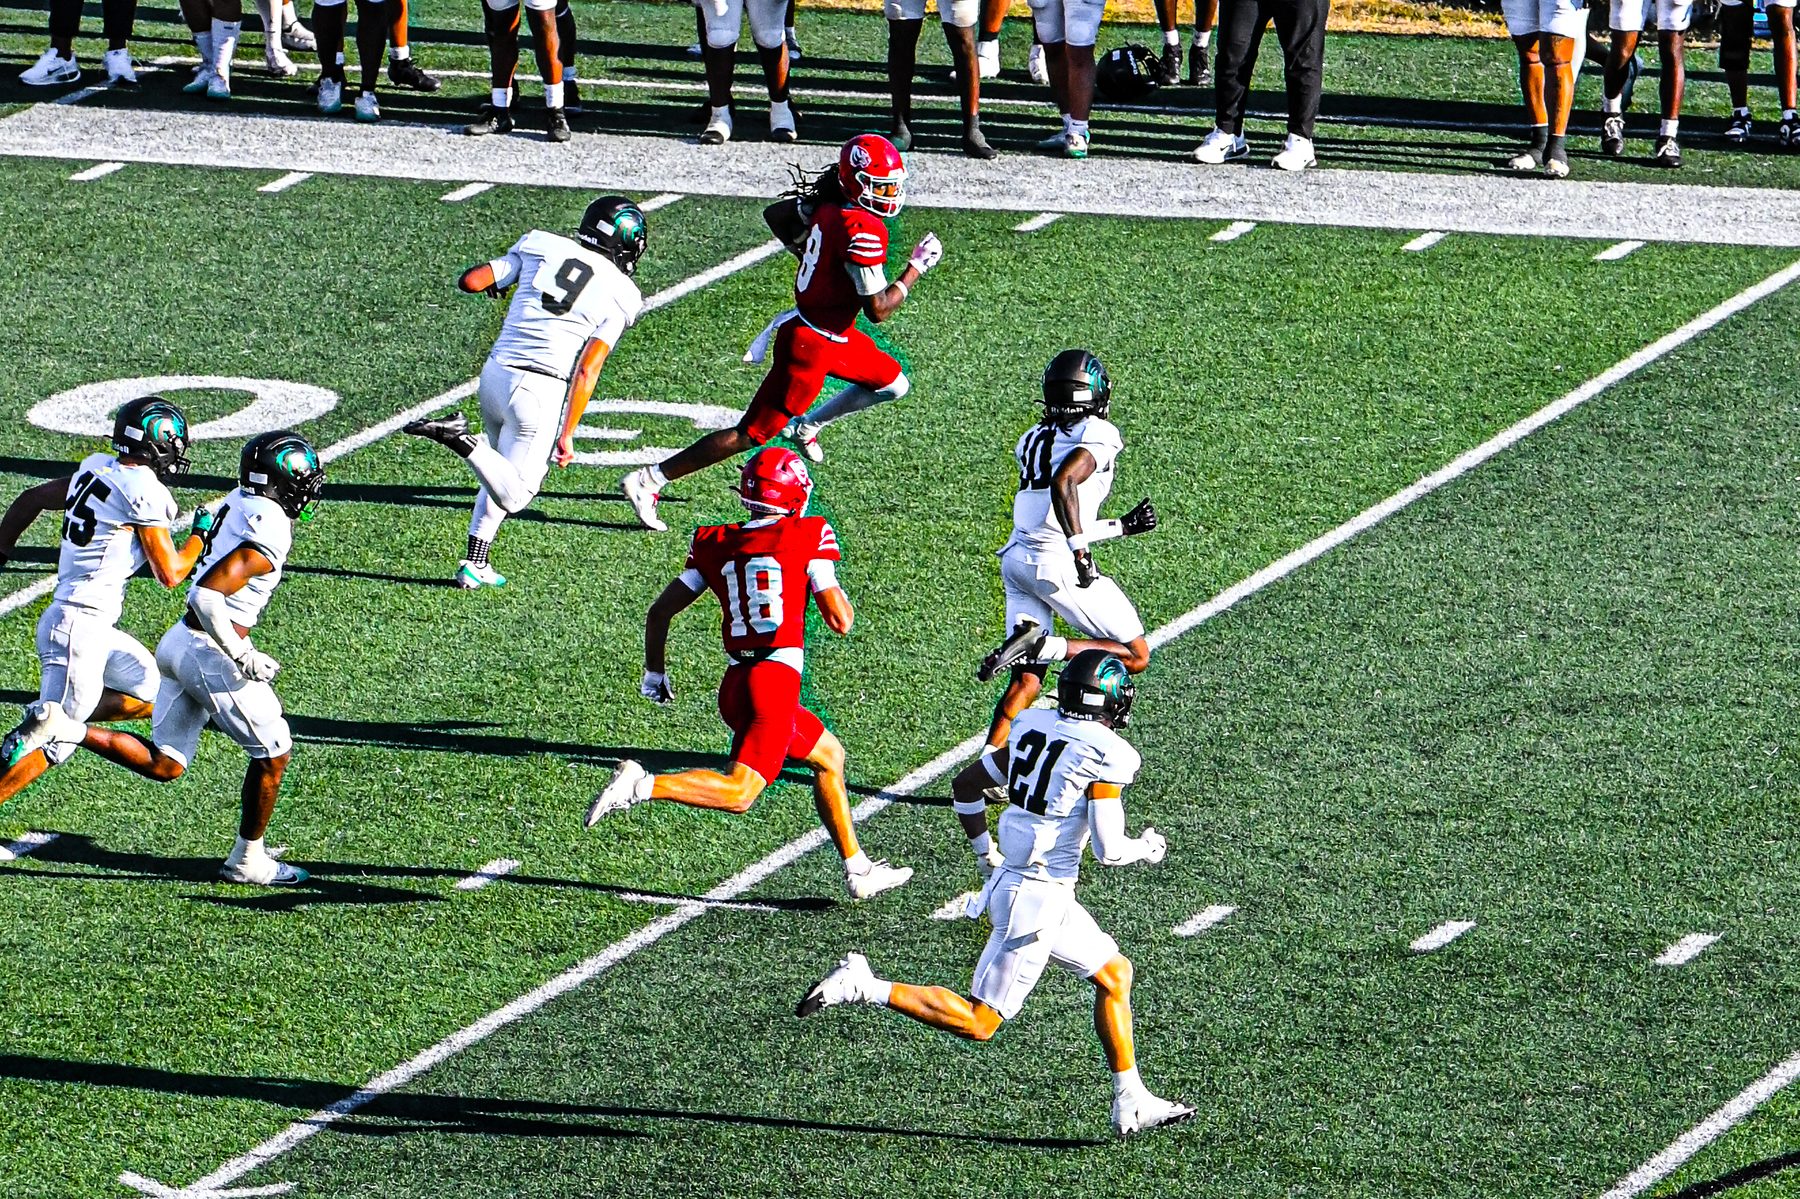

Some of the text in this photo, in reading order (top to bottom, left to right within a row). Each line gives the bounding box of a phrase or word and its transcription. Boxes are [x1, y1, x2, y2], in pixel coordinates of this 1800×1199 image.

[541, 258, 595, 316] 9
[796, 222, 823, 293] 8
[62, 469, 112, 547] 25
[721, 556, 784, 637] 18
[1008, 728, 1069, 817] 21
